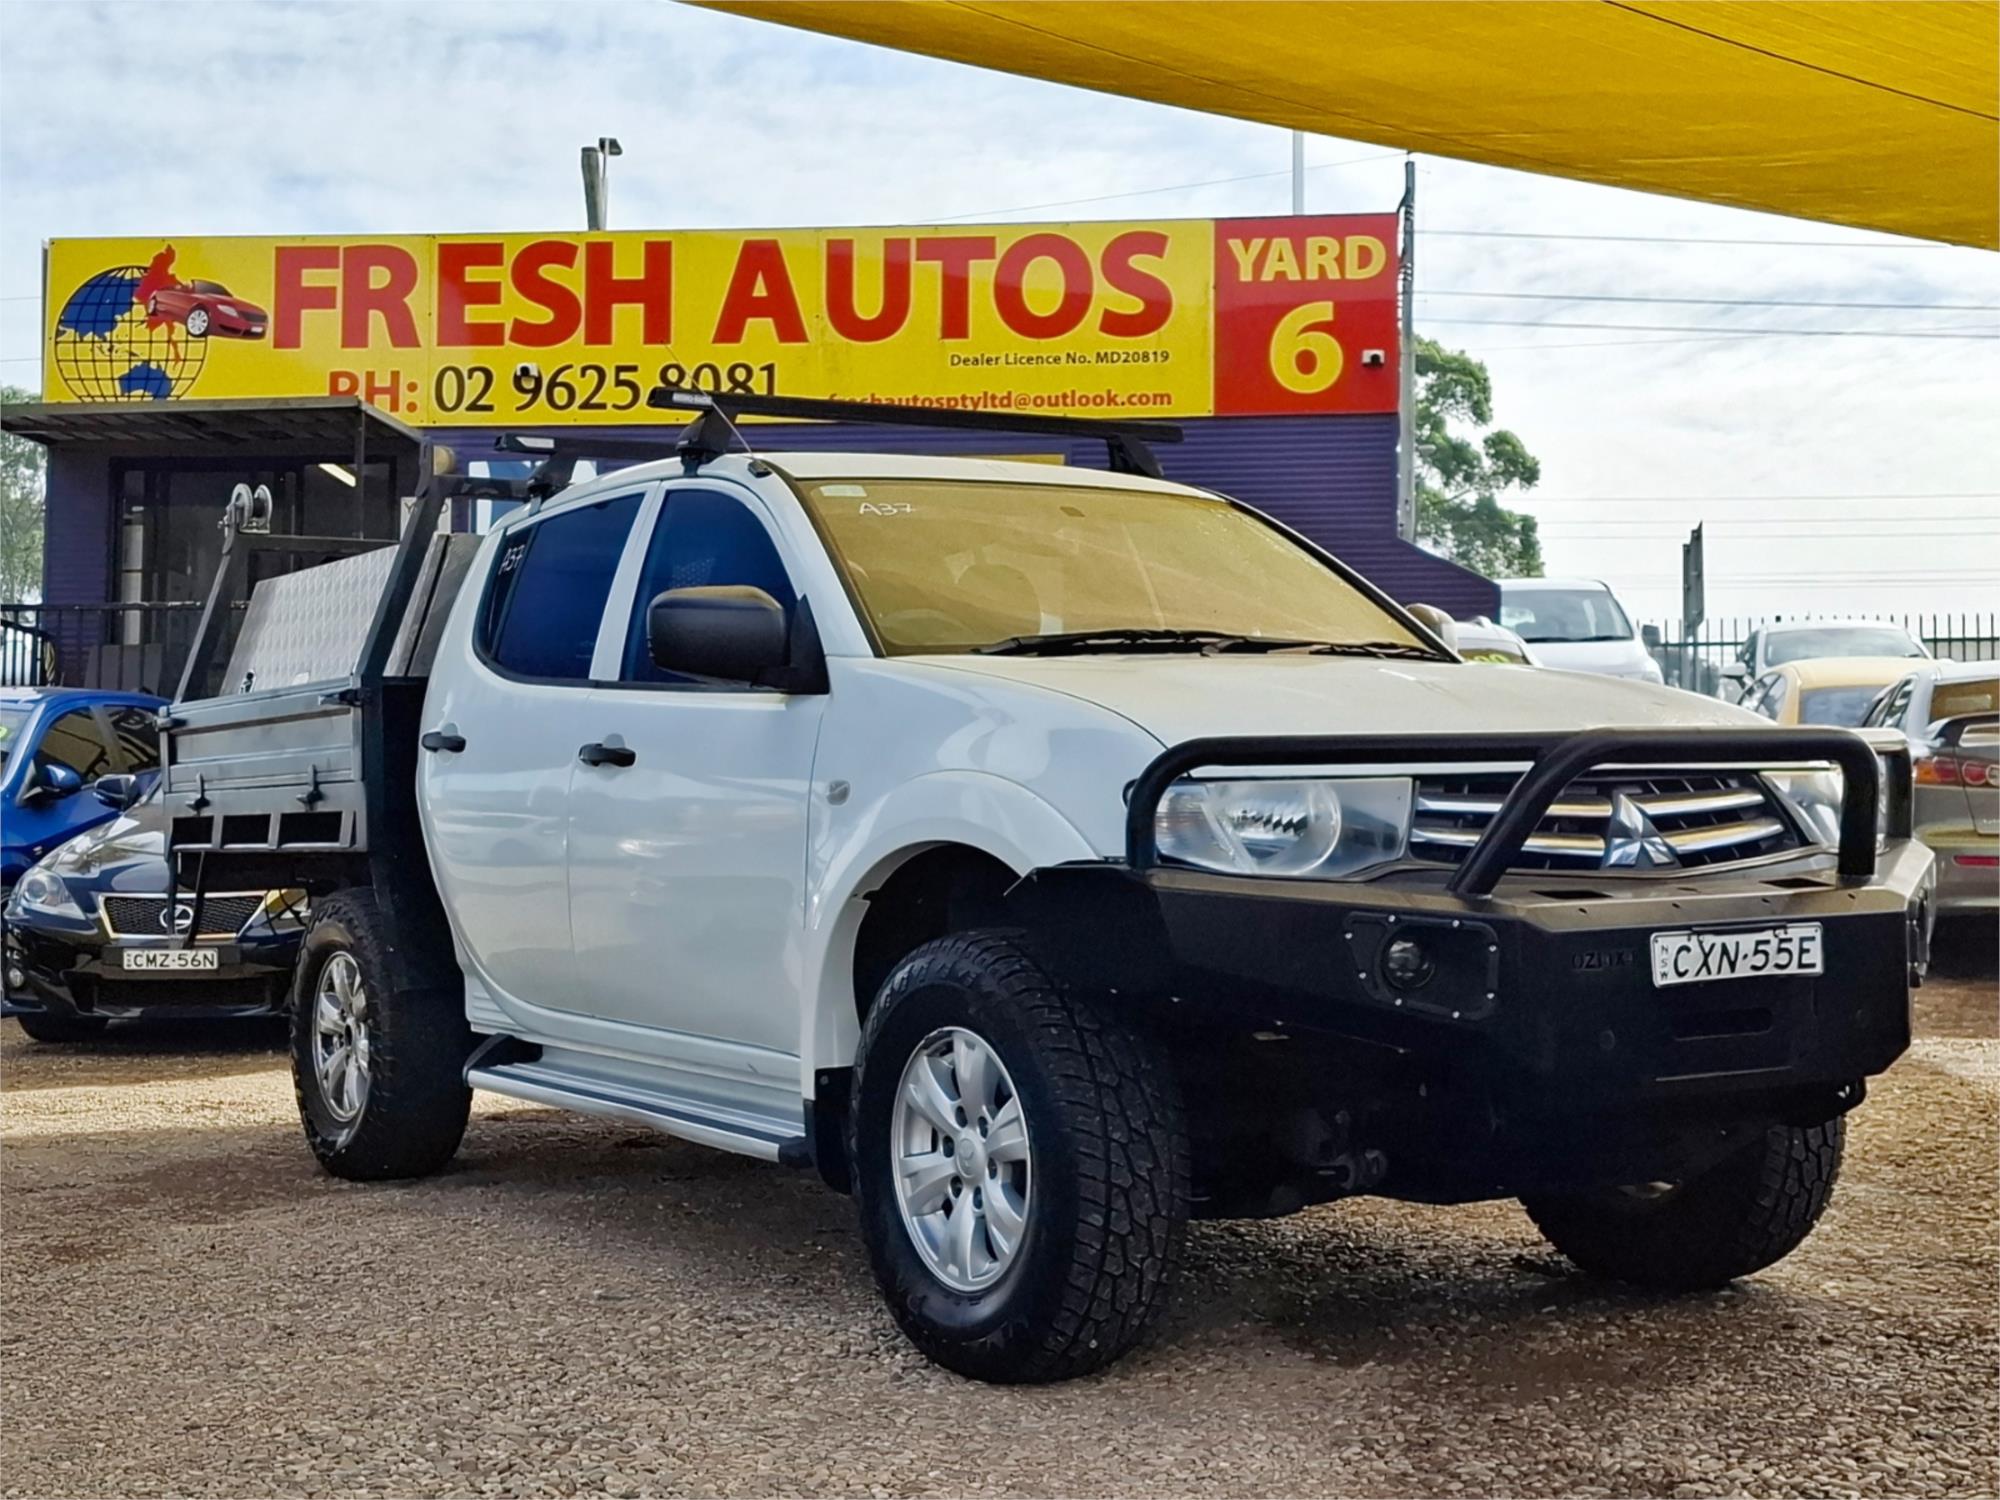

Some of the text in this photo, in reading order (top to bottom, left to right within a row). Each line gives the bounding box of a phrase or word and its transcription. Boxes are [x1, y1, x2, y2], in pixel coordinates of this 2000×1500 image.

[1227, 235, 1387, 282] YARD
[272, 230, 1174, 350] FRESH AUTOS
[950, 350, 1171, 367] Dealer Licence No. MD20819
[1270, 301, 1344, 394] 6
[329, 370, 418, 413] PH:
[434, 366, 494, 412] 02
[512, 363, 641, 412] 9625
